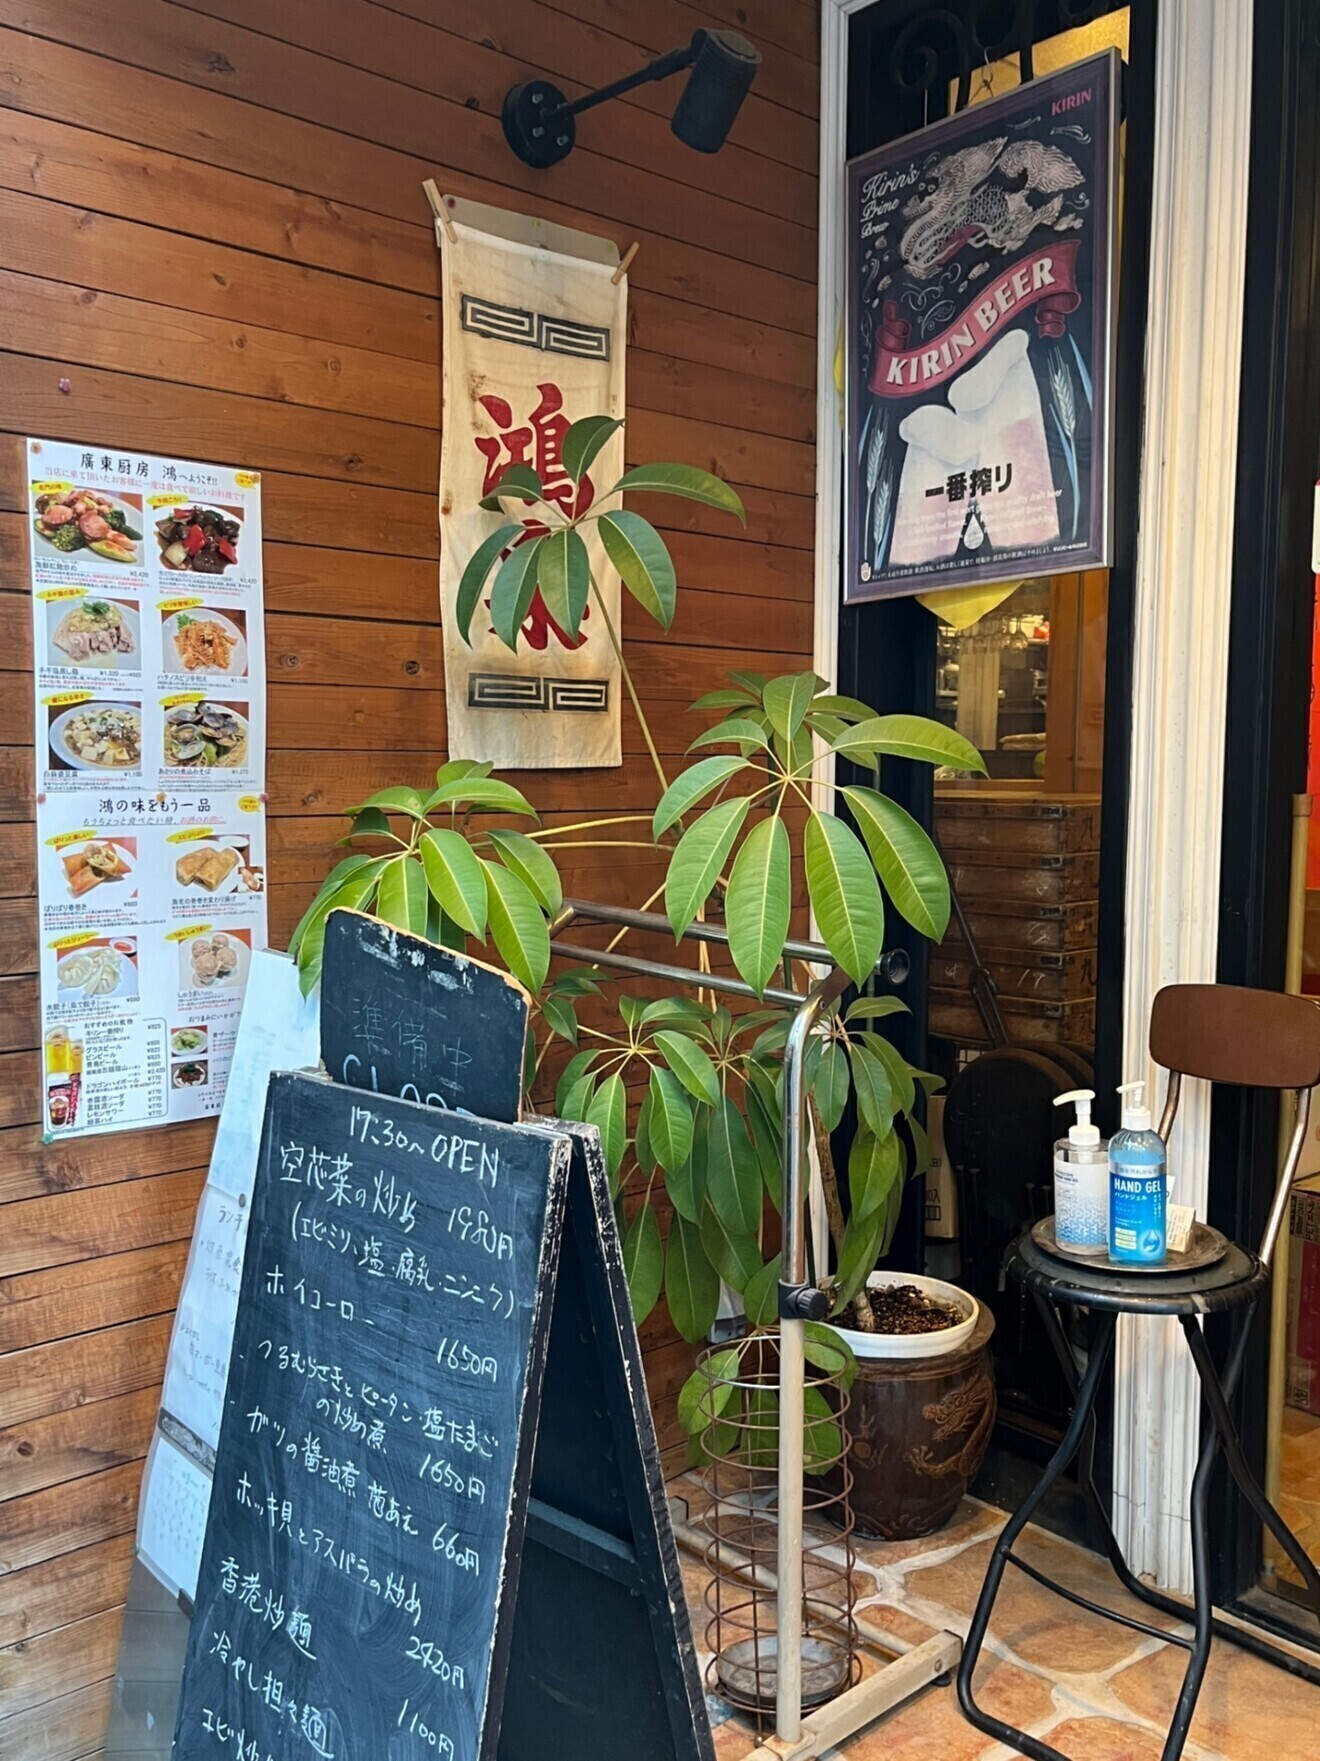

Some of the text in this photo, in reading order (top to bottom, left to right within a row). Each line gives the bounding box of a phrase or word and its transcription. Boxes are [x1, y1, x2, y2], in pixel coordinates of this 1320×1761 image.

[1051, 88, 1092, 116] KIRIN
[886, 257, 1056, 385] KIRIN BEER
[81, 453, 149, 477] 廣東厨房
[925, 463, 1012, 502] 一番搾り
[99, 797, 210, 814] 鴻の味をもう一品
[86, 1044, 122, 1053] グラスビール
[353, 994, 473, 1097] 準備中
[86, 1079, 139, 1088] ドラゴンハイボール
[87, 1109, 123, 1119] レモンサワー
[431, 1134, 499, 1188] OPEN
[1114, 1178, 1161, 1193] HAND GEL
[280, 1141, 513, 1260] 空芯菜の炒め 1980円
[266, 1264, 375, 1325] ホイコーロー
[437, 1337, 498, 1382] 1650円
[316, 1398, 485, 1504] の炒め煮 1650円
[237, 1471, 421, 1626] ホッキ貝とアスパラの炒め
[432, 1523, 479, 1576] 660円
[406, 1636, 464, 1689] 2420円
[399, 1699, 454, 1761] 1100円
